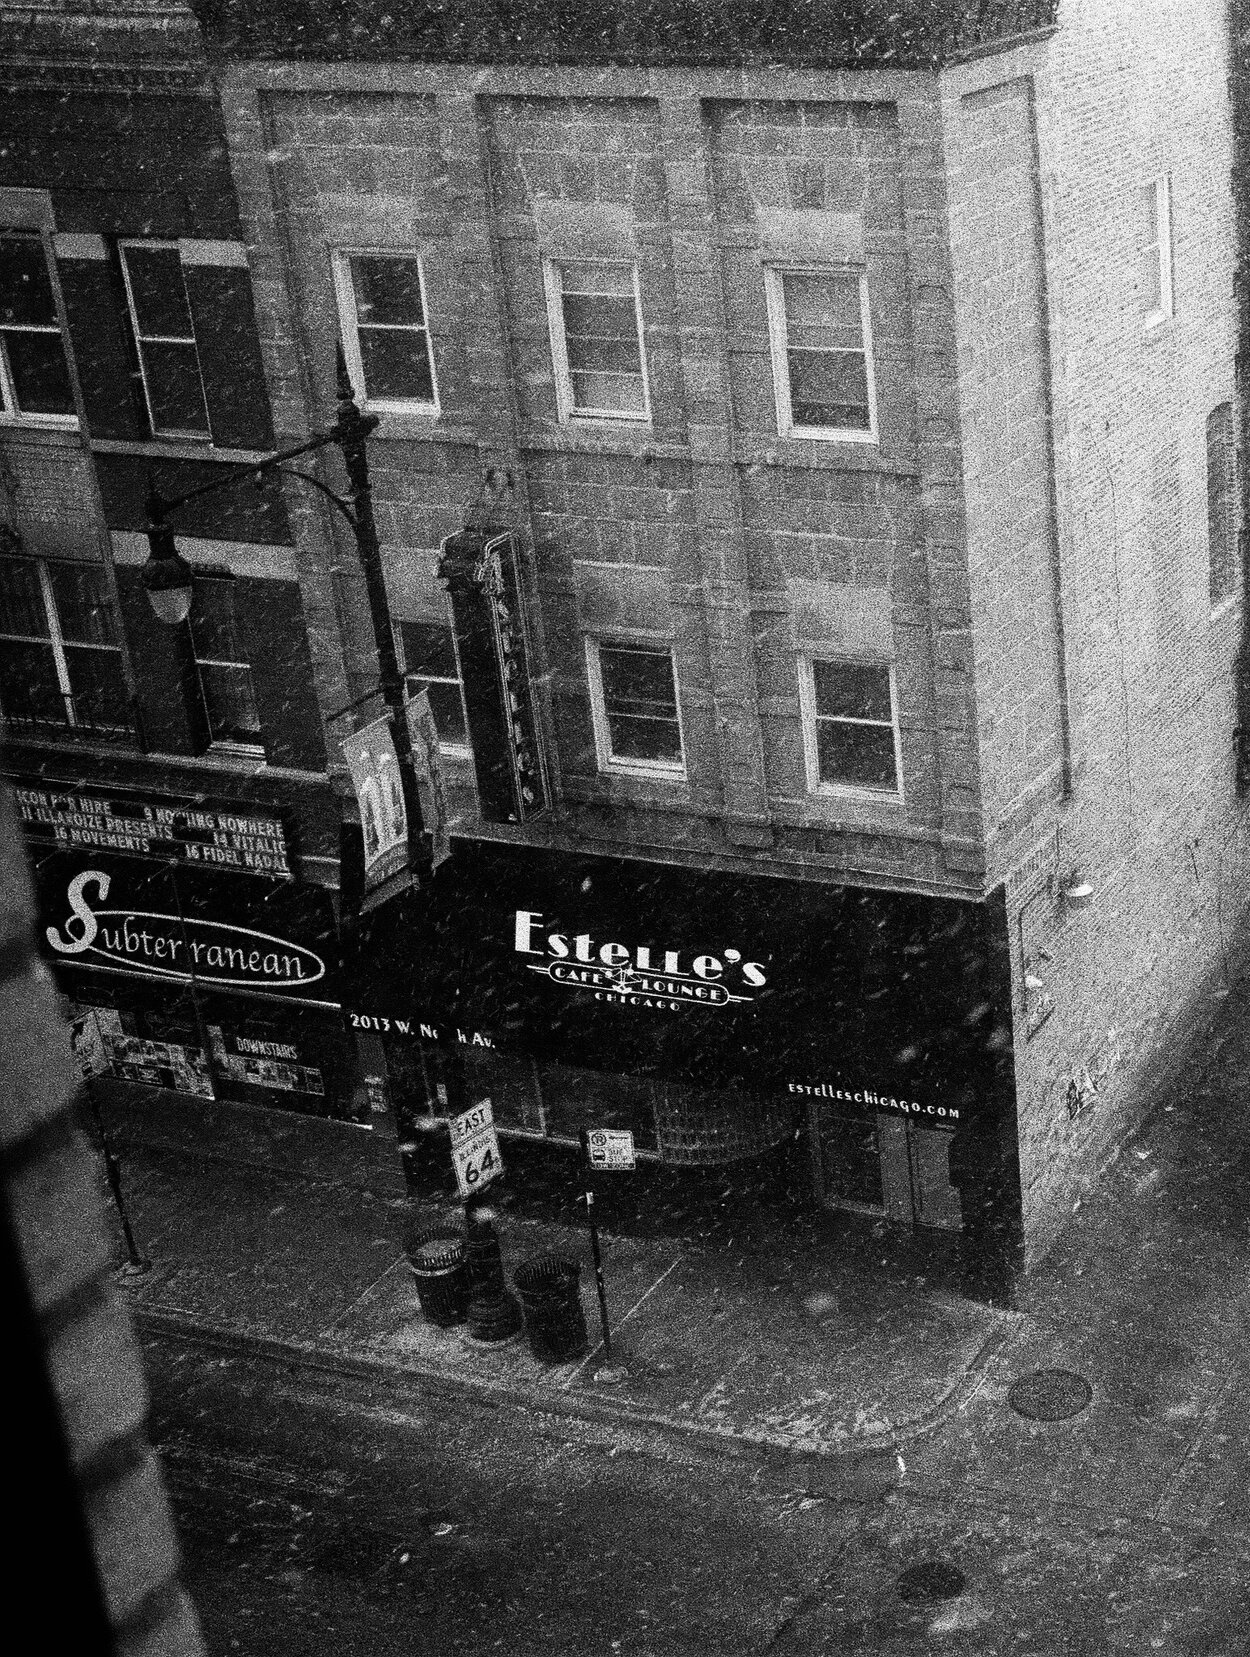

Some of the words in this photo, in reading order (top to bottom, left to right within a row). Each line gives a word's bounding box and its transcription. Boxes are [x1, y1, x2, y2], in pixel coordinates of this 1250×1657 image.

[80, 798, 112, 816] HIRE
[105, 816, 173, 841] PRESENTS
[217, 813, 285, 838] NOWHERE
[54, 825, 68, 840] 16
[70, 828, 150, 852] MOVEMENTS
[213, 831, 229, 848] 14
[231, 834, 288, 856] VITALIC
[185, 843, 200, 859] 16
[203, 846, 242, 866] FIDEL
[244, 851, 290, 872] NADAL
[594, 992, 680, 1012] CHICAGO
[641, 979, 722, 1001] LOUNGE
[350, 1013, 390, 1032] 2013
[395, 1019, 415, 1036] W.
[473, 1032, 496, 1049] Av.
[235, 1036, 298, 1060] DOWNSTAIRS
[457, 1108, 485, 1137] EAST
[466, 1149, 496, 1184] 64
